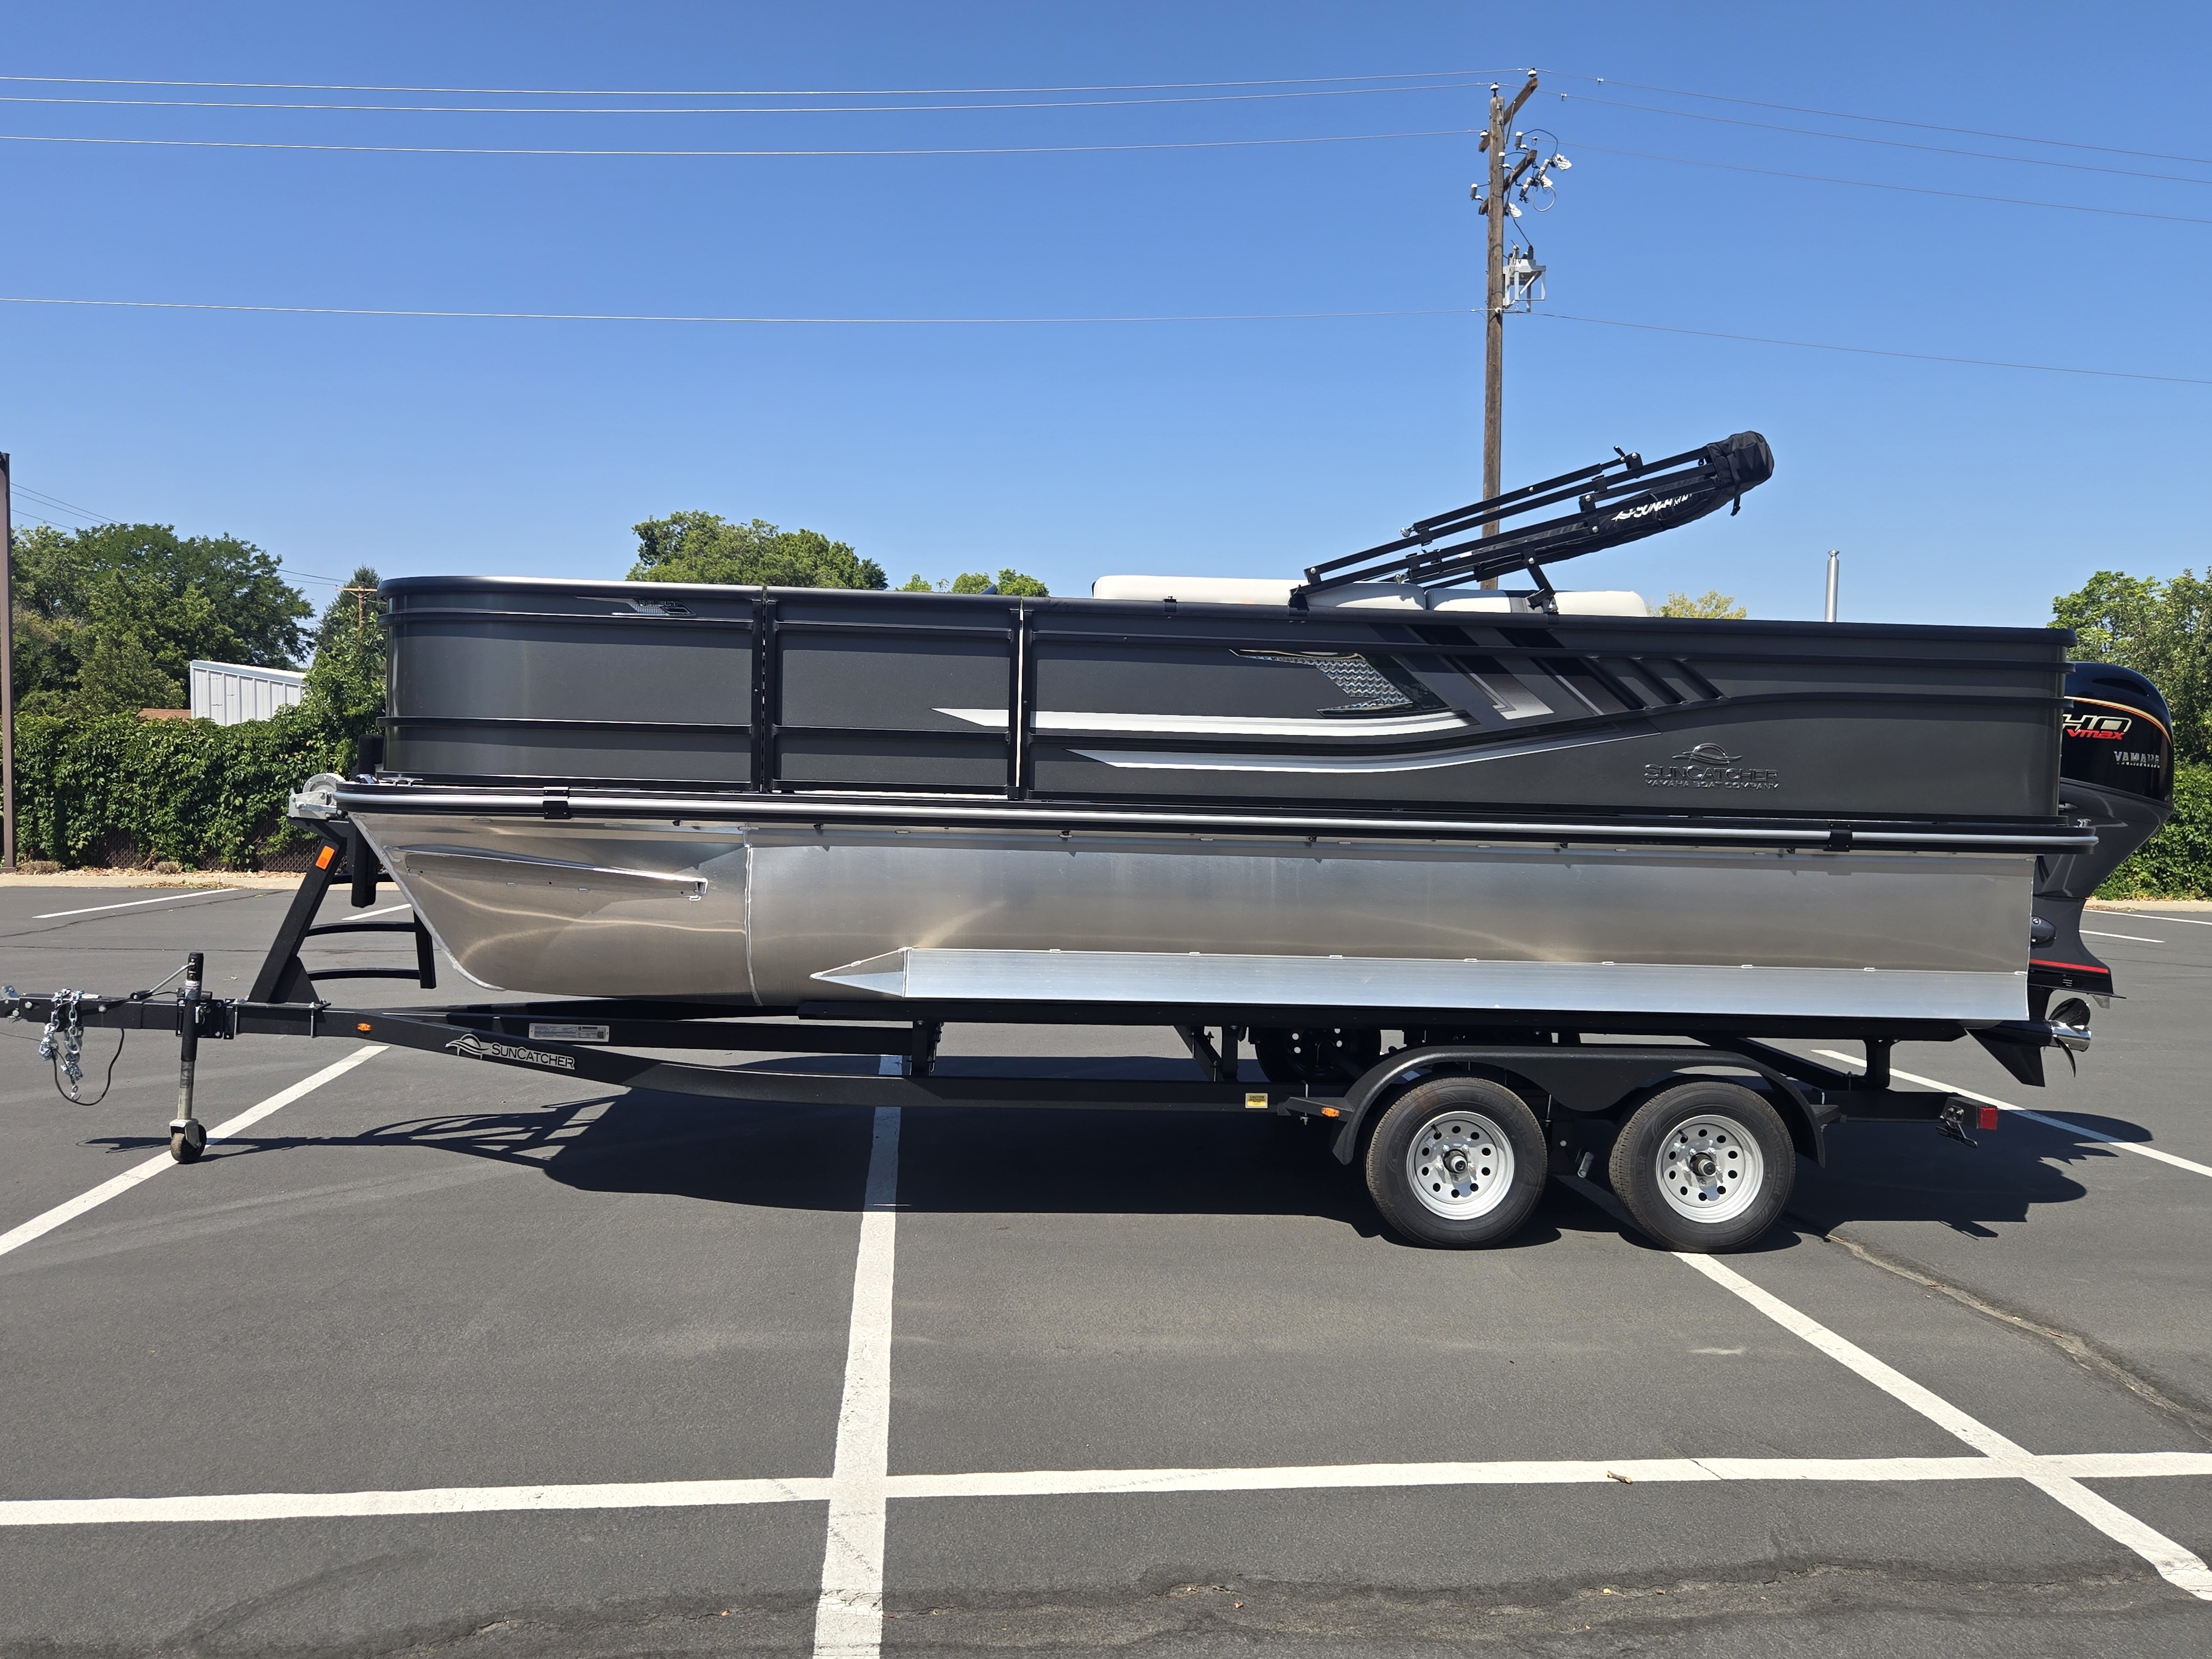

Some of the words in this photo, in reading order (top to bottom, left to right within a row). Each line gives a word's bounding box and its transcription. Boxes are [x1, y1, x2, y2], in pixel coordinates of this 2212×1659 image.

[2114, 751, 2160, 768] YAMAHA
[1725, 781, 1779, 790] COMPANY
[491, 1042, 575, 1068] SUNCATCHER
